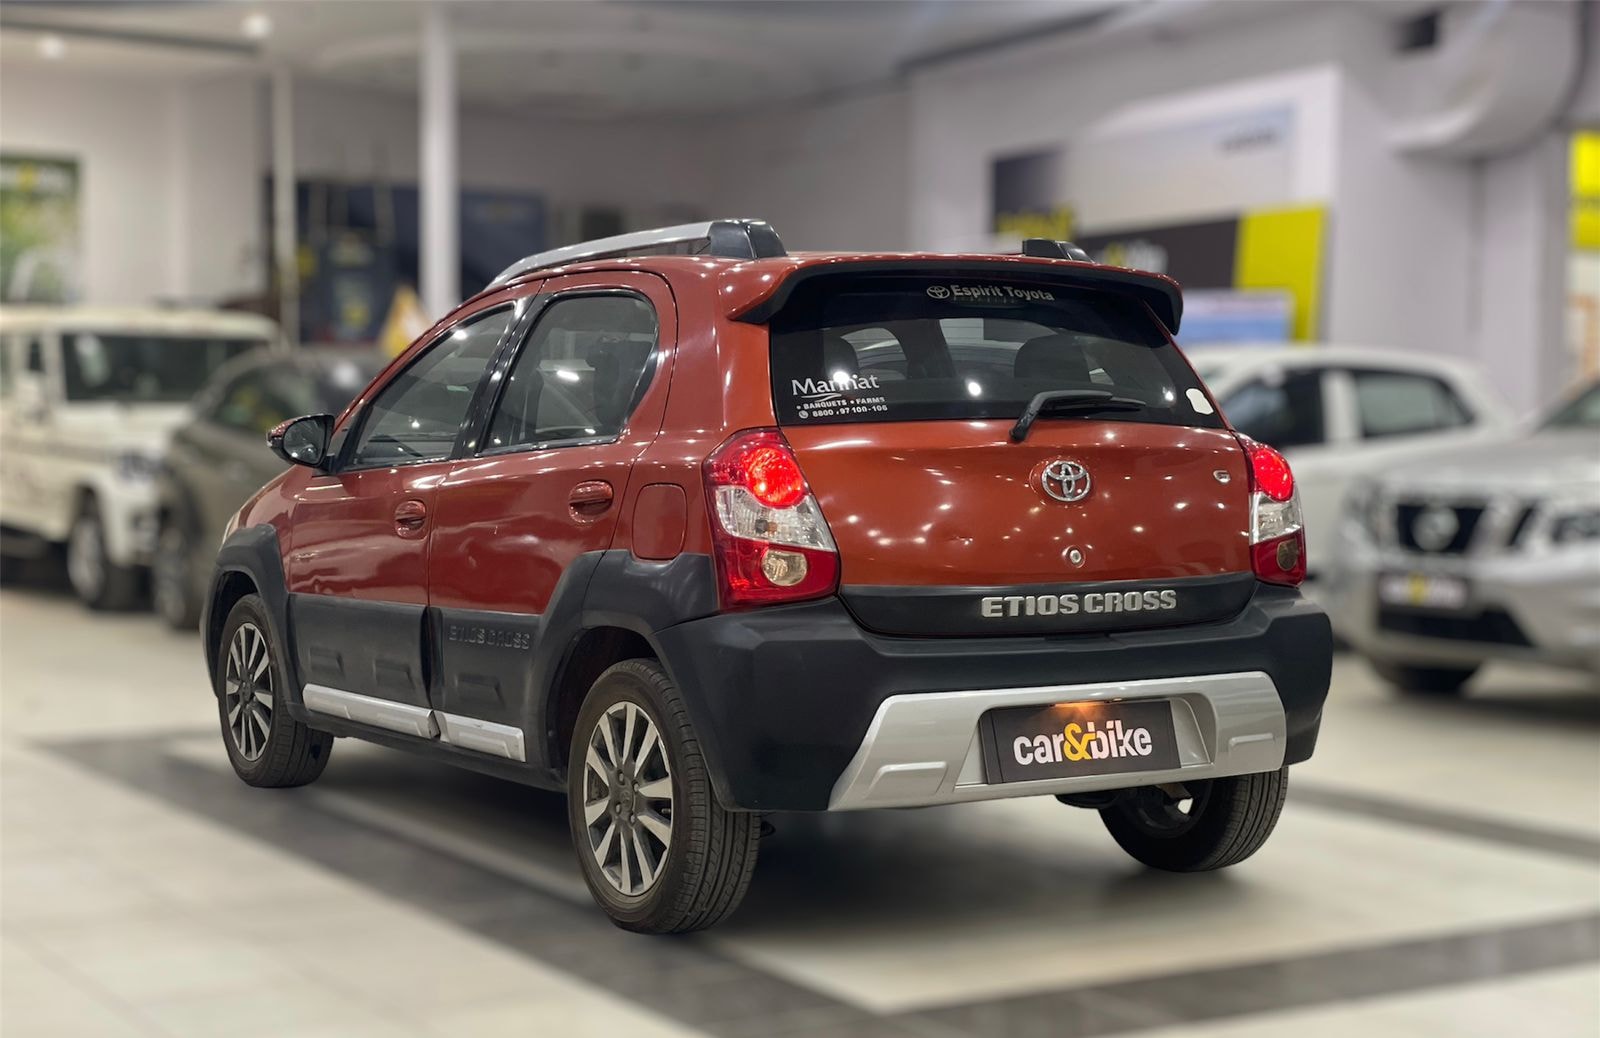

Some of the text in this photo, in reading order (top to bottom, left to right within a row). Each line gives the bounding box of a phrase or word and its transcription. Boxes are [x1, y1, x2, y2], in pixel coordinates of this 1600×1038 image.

[950, 284, 1003, 298] Espirit
[1003, 286, 1055, 301] Toyota
[803, 396, 885, 410] BANQUETS FARMS
[981, 589, 1177, 618] ETIOS CROSS
[1013, 720, 1153, 766] car&bike
